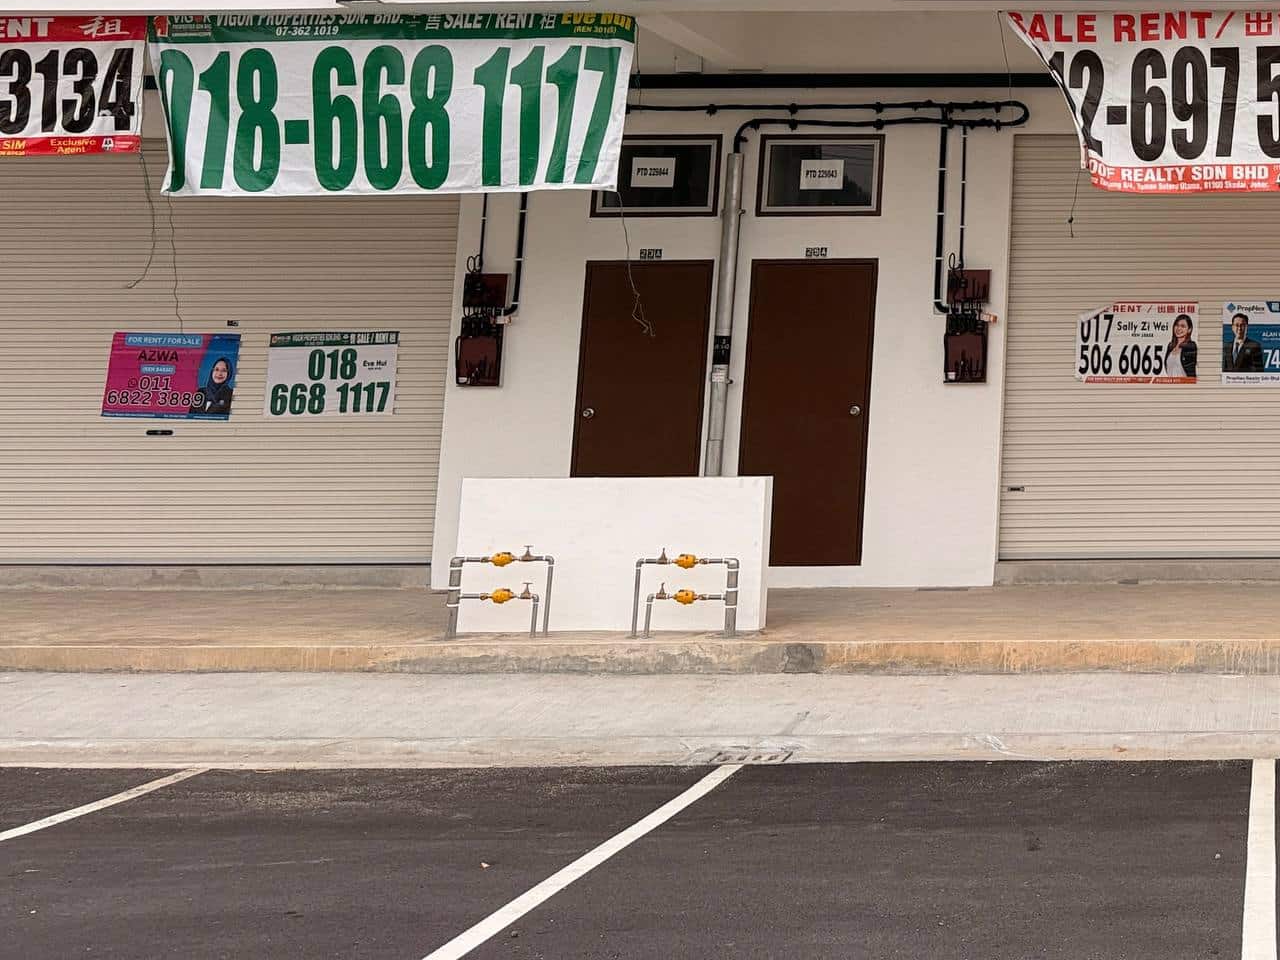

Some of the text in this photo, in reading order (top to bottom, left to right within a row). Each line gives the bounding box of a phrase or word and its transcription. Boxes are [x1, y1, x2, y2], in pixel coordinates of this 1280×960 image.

[444, 13, 483, 29] SALE
[275, 25, 340, 36] 07-362 1019
[473, 45, 623, 187] 1117
[56, 146, 86, 155] Agent
[1121, 166, 1186, 182] REALTY
[1191, 166, 1228, 181] SDN
[1232, 165, 1270, 180] BHD
[1113, 305, 1142, 313] RENT
[1117, 321, 1138, 333] Sally
[138, 350, 179, 361] AZWA
[1079, 344, 1163, 375] 506 6065
[308, 348, 358, 381] 018
[139, 376, 172, 391] 011
[107, 391, 205, 407] 6822 3889
[270, 381, 391, 416] 668 1117
